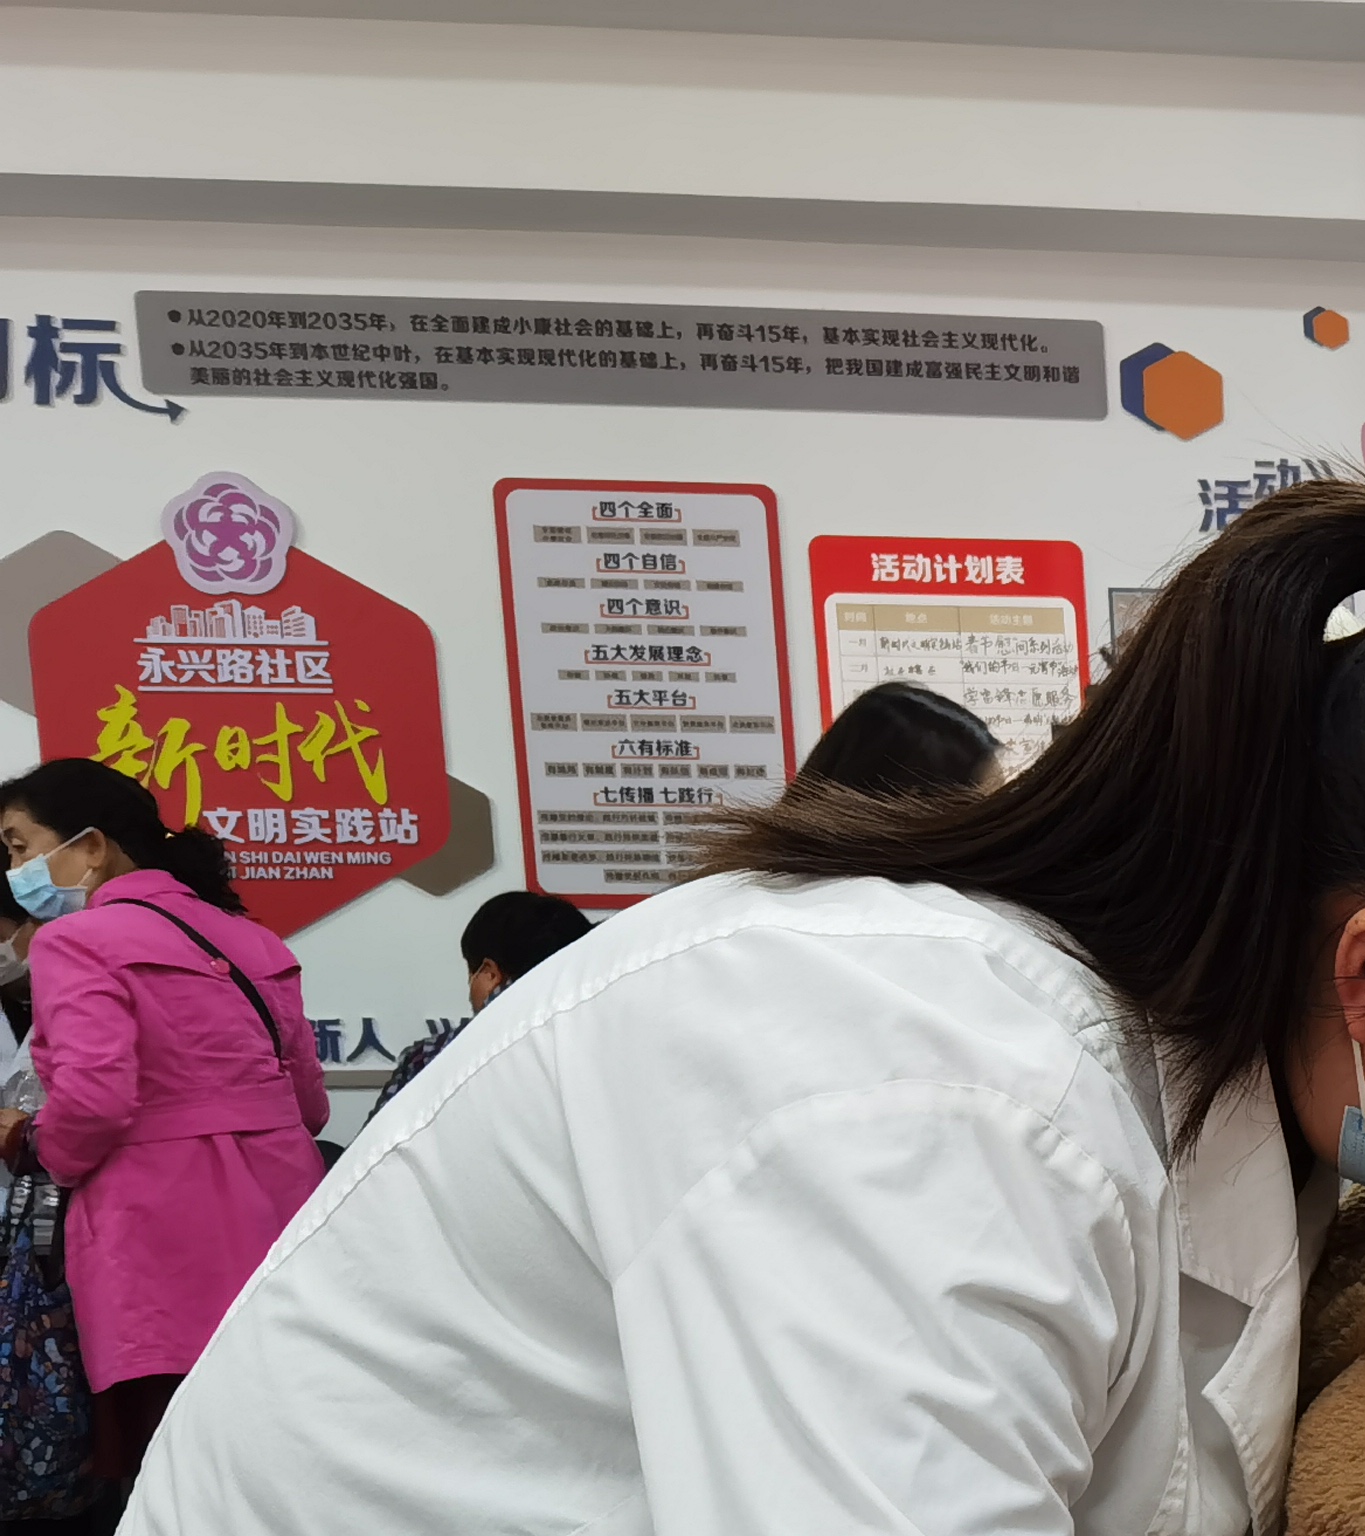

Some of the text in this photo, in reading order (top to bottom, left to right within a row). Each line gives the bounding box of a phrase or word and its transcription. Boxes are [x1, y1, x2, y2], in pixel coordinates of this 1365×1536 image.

[190, 366, 450, 392] 美丽的社会主义现代化强国。
[599, 501, 674, 519] 四个全面
[603, 552, 678, 570] 四个自信
[870, 551, 1027, 586] 活动计划表
[606, 598, 682, 616] 四个意识
[591, 644, 704, 663] 五大发展理念
[137, 647, 334, 686] 永兴路社区
[614, 689, 688, 707] 五大平台
[89, 684, 390, 829] 新时代
[618, 739, 693, 757] 六有标准
[600, 786, 714, 804] 七传播 七践行
[203, 805, 419, 846] 文明实践站
[239, 851, 392, 865] SHI DAI WEN MING
[239, 866, 334, 880] JIAN ZHAN
